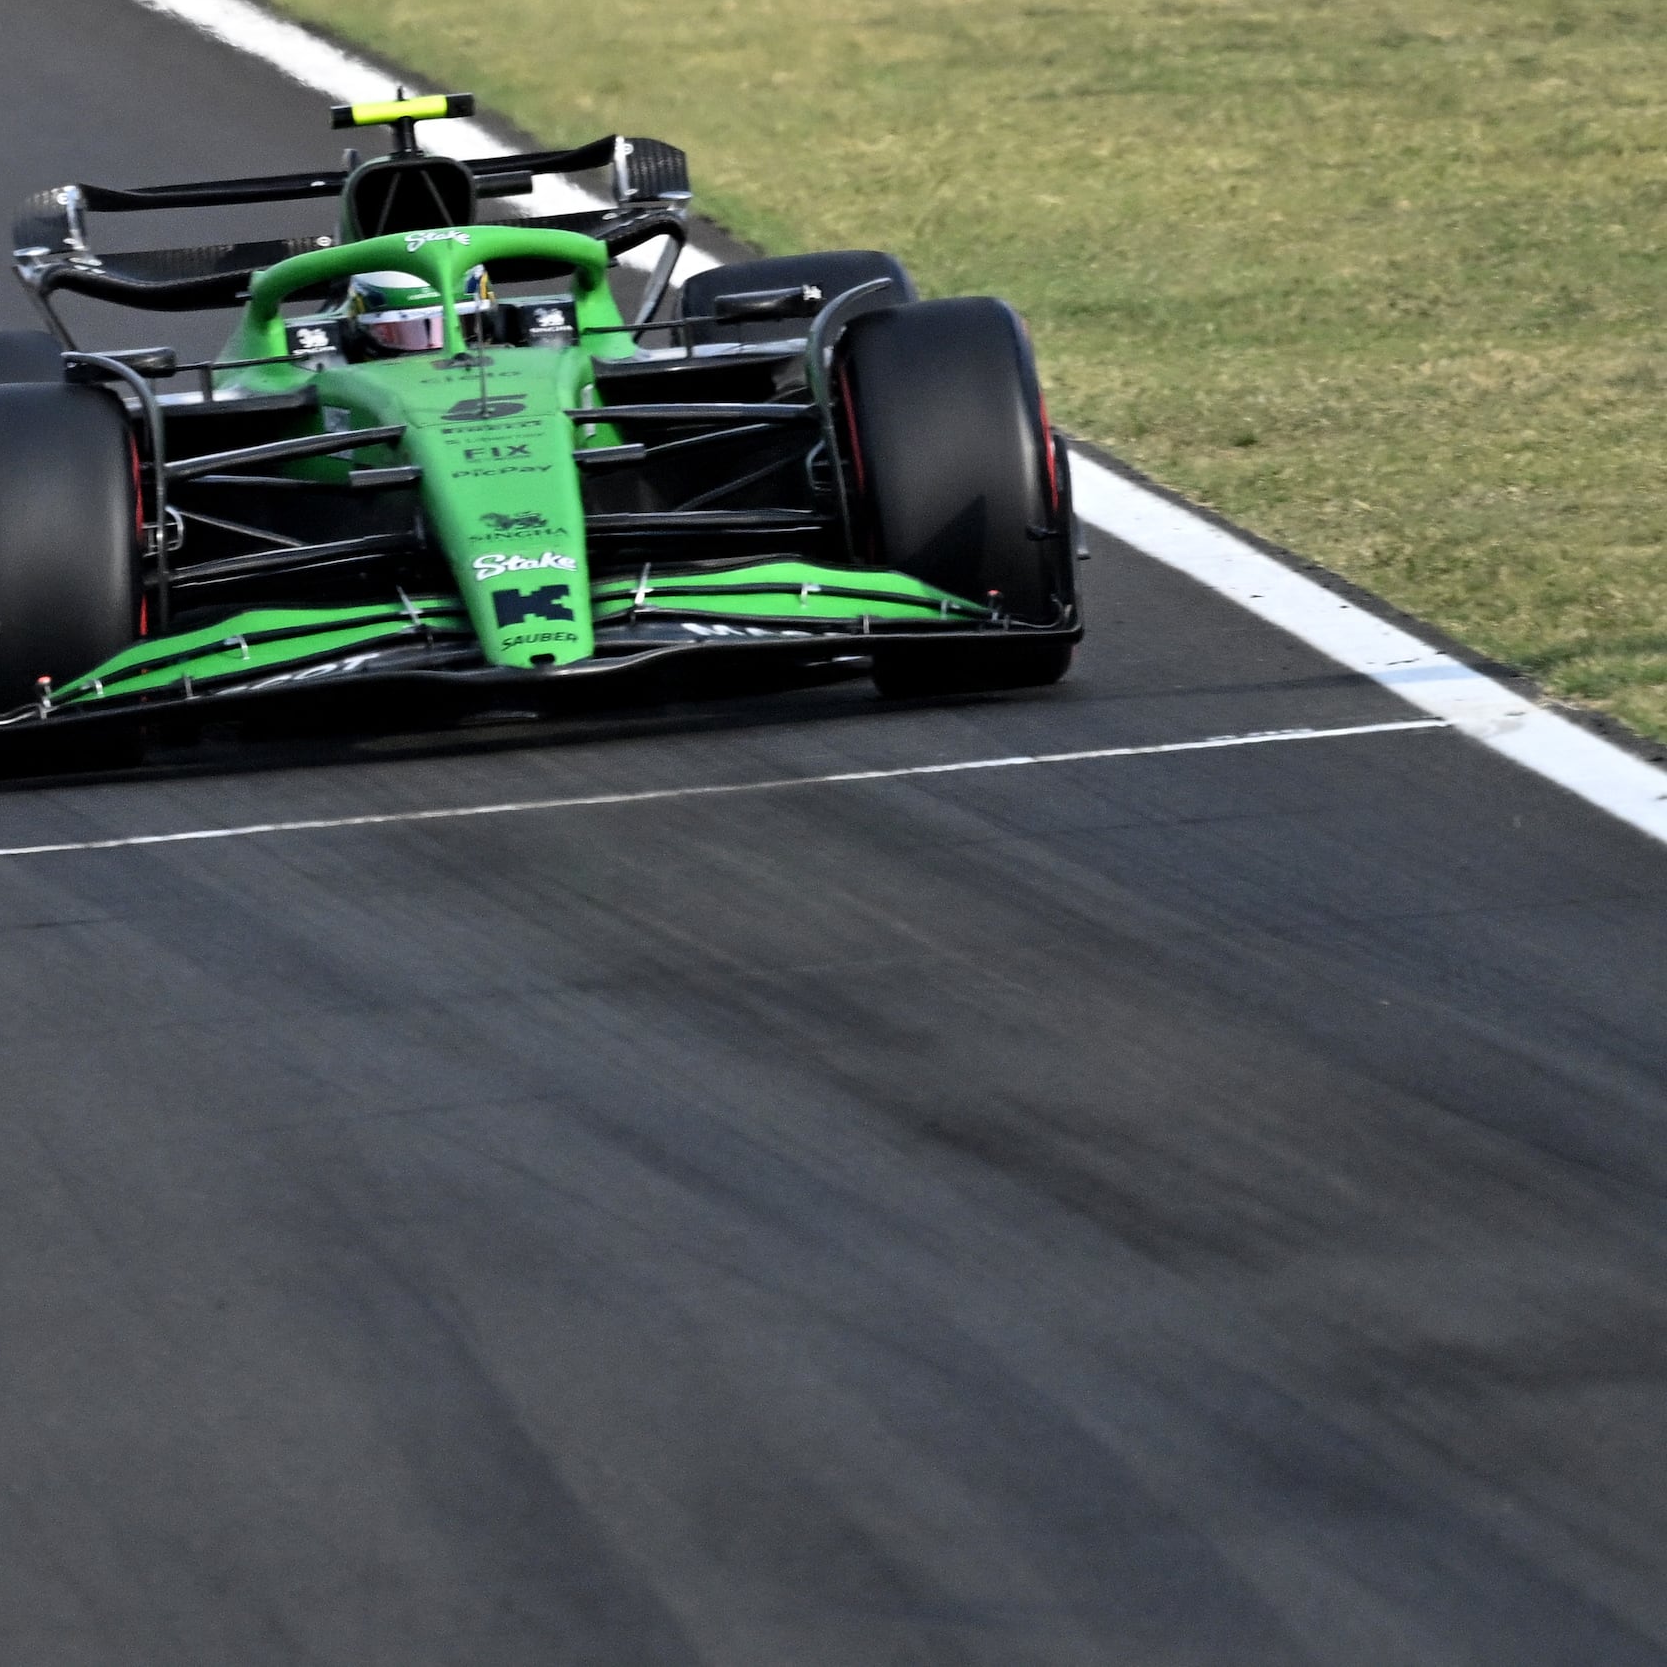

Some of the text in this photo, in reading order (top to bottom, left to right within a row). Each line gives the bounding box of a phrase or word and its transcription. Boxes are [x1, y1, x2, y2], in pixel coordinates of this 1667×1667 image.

[403, 229, 471, 252] Stake
[440, 393, 528, 421] 5
[464, 444, 531, 460] FIX
[468, 527, 568, 542] SINGHA
[472, 551, 577, 582] Stake
[501, 632, 579, 651] SAUBER
